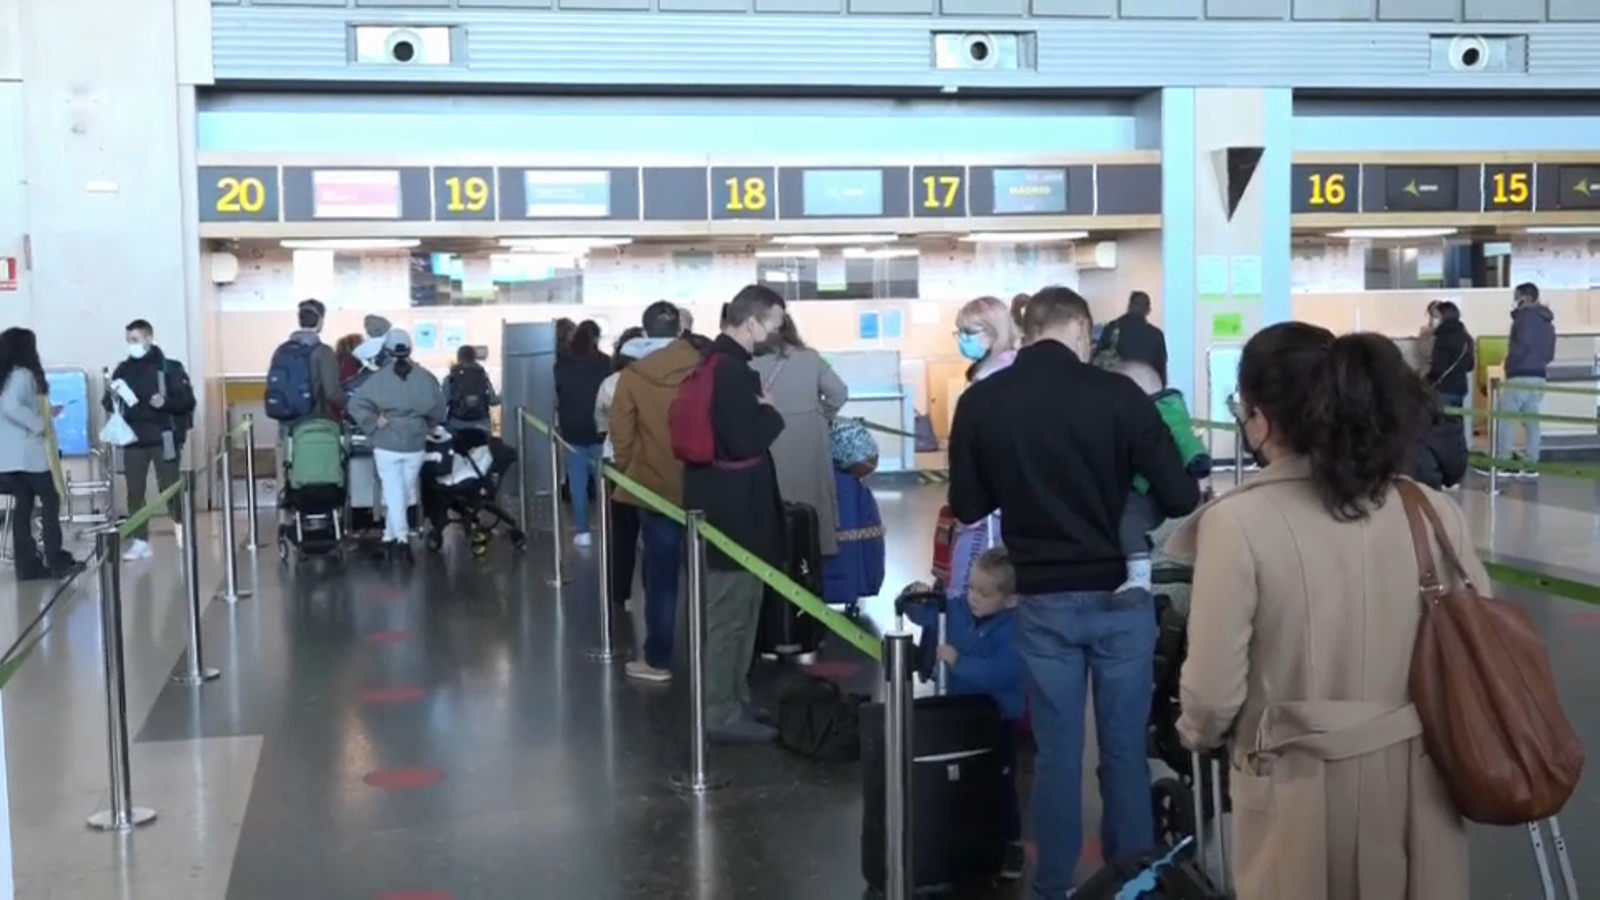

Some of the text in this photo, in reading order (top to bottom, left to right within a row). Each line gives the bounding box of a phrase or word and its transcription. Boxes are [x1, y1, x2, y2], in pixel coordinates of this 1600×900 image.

[216, 177, 265, 212] 20
[446, 177, 488, 211] 19
[725, 178, 767, 211] 18
[923, 176, 962, 209] 17
[1008, 185, 1052, 196] MADRID
[1308, 173, 1346, 205] 16
[1492, 172, 1529, 204] 15
